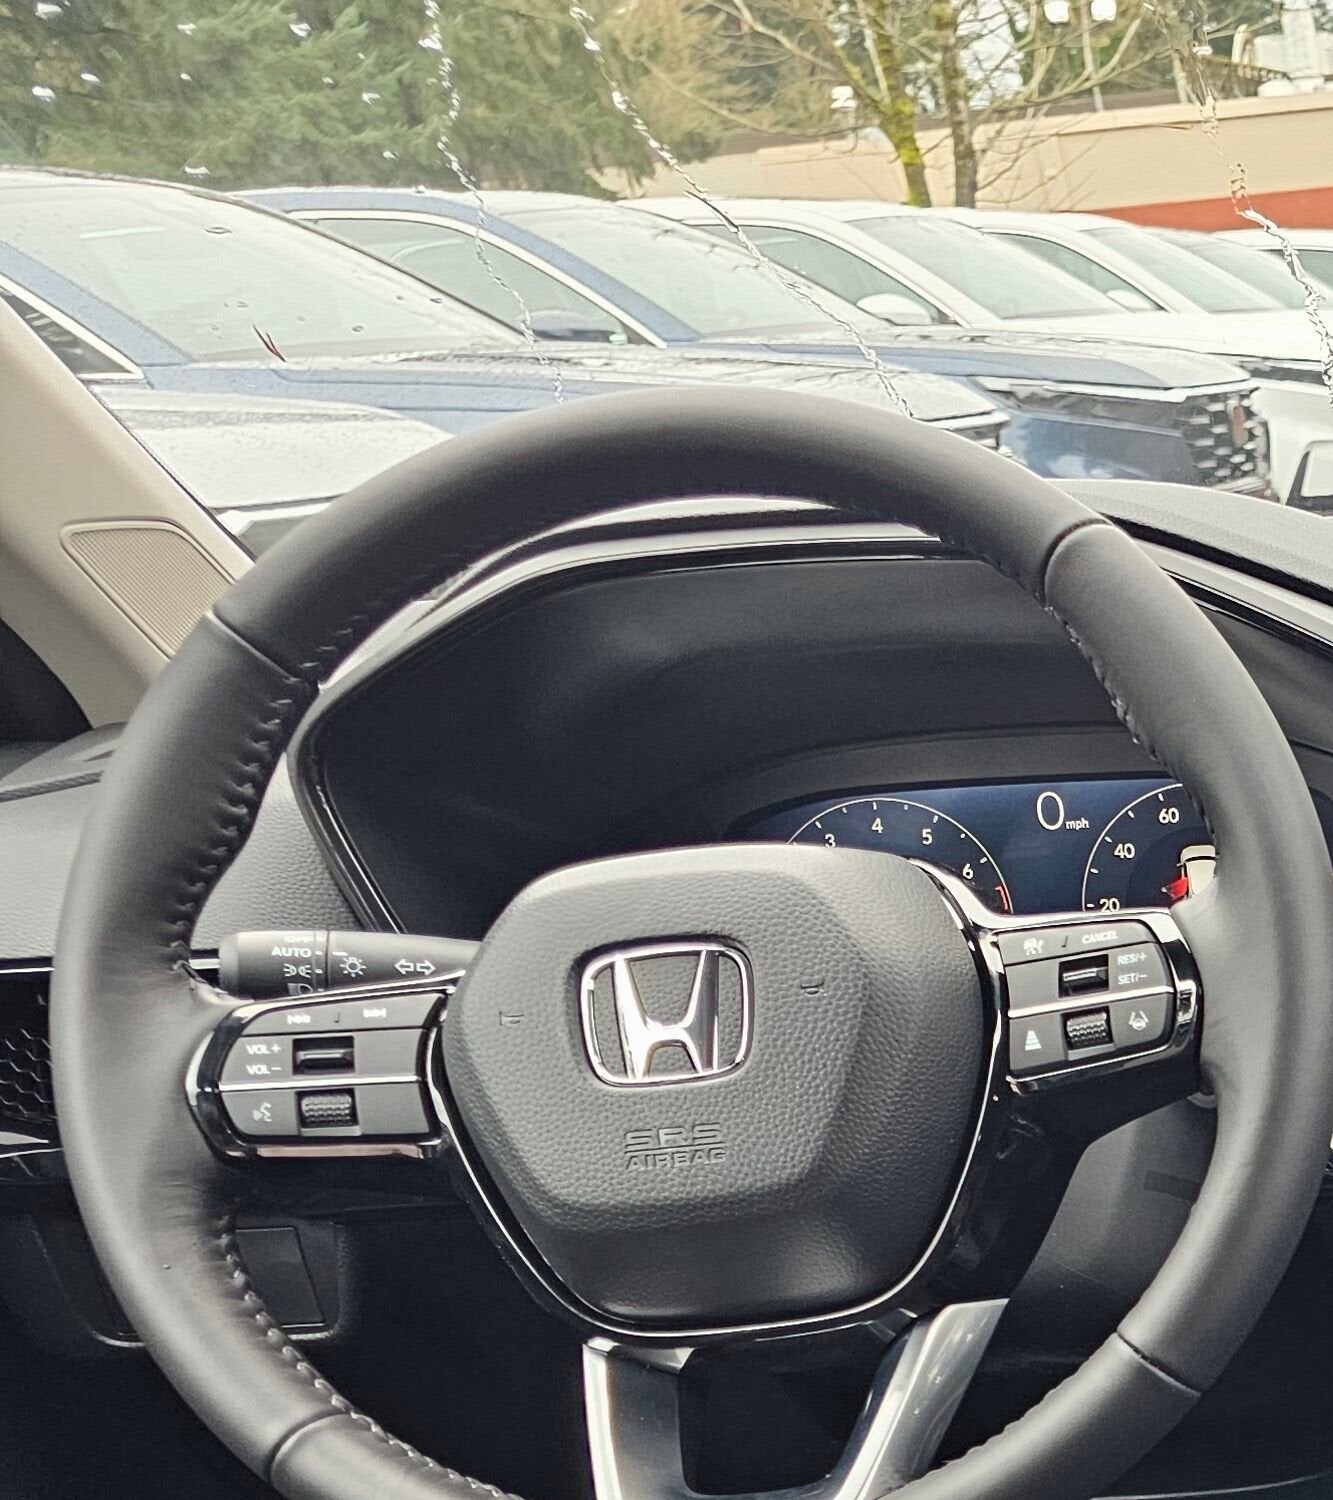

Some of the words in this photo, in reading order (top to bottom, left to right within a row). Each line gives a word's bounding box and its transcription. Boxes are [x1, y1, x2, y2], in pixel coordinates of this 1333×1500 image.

[1036, 791, 1065, 831] 0
[1065, 816, 1090, 832] mph
[1158, 807, 1180, 824] 60
[871, 817, 883, 834] 4
[824, 833, 837, 848] 3
[921, 828, 933, 845] 5
[1114, 842, 1136, 860] 40
[962, 863, 974, 880] 6
[1099, 897, 1120, 912] 20
[1082, 930, 1119, 945] CANCEL
[271, 946, 312, 958] AUTO
[624, 1121, 722, 1150] SRS
[626, 1149, 727, 1171] AIRBAG
